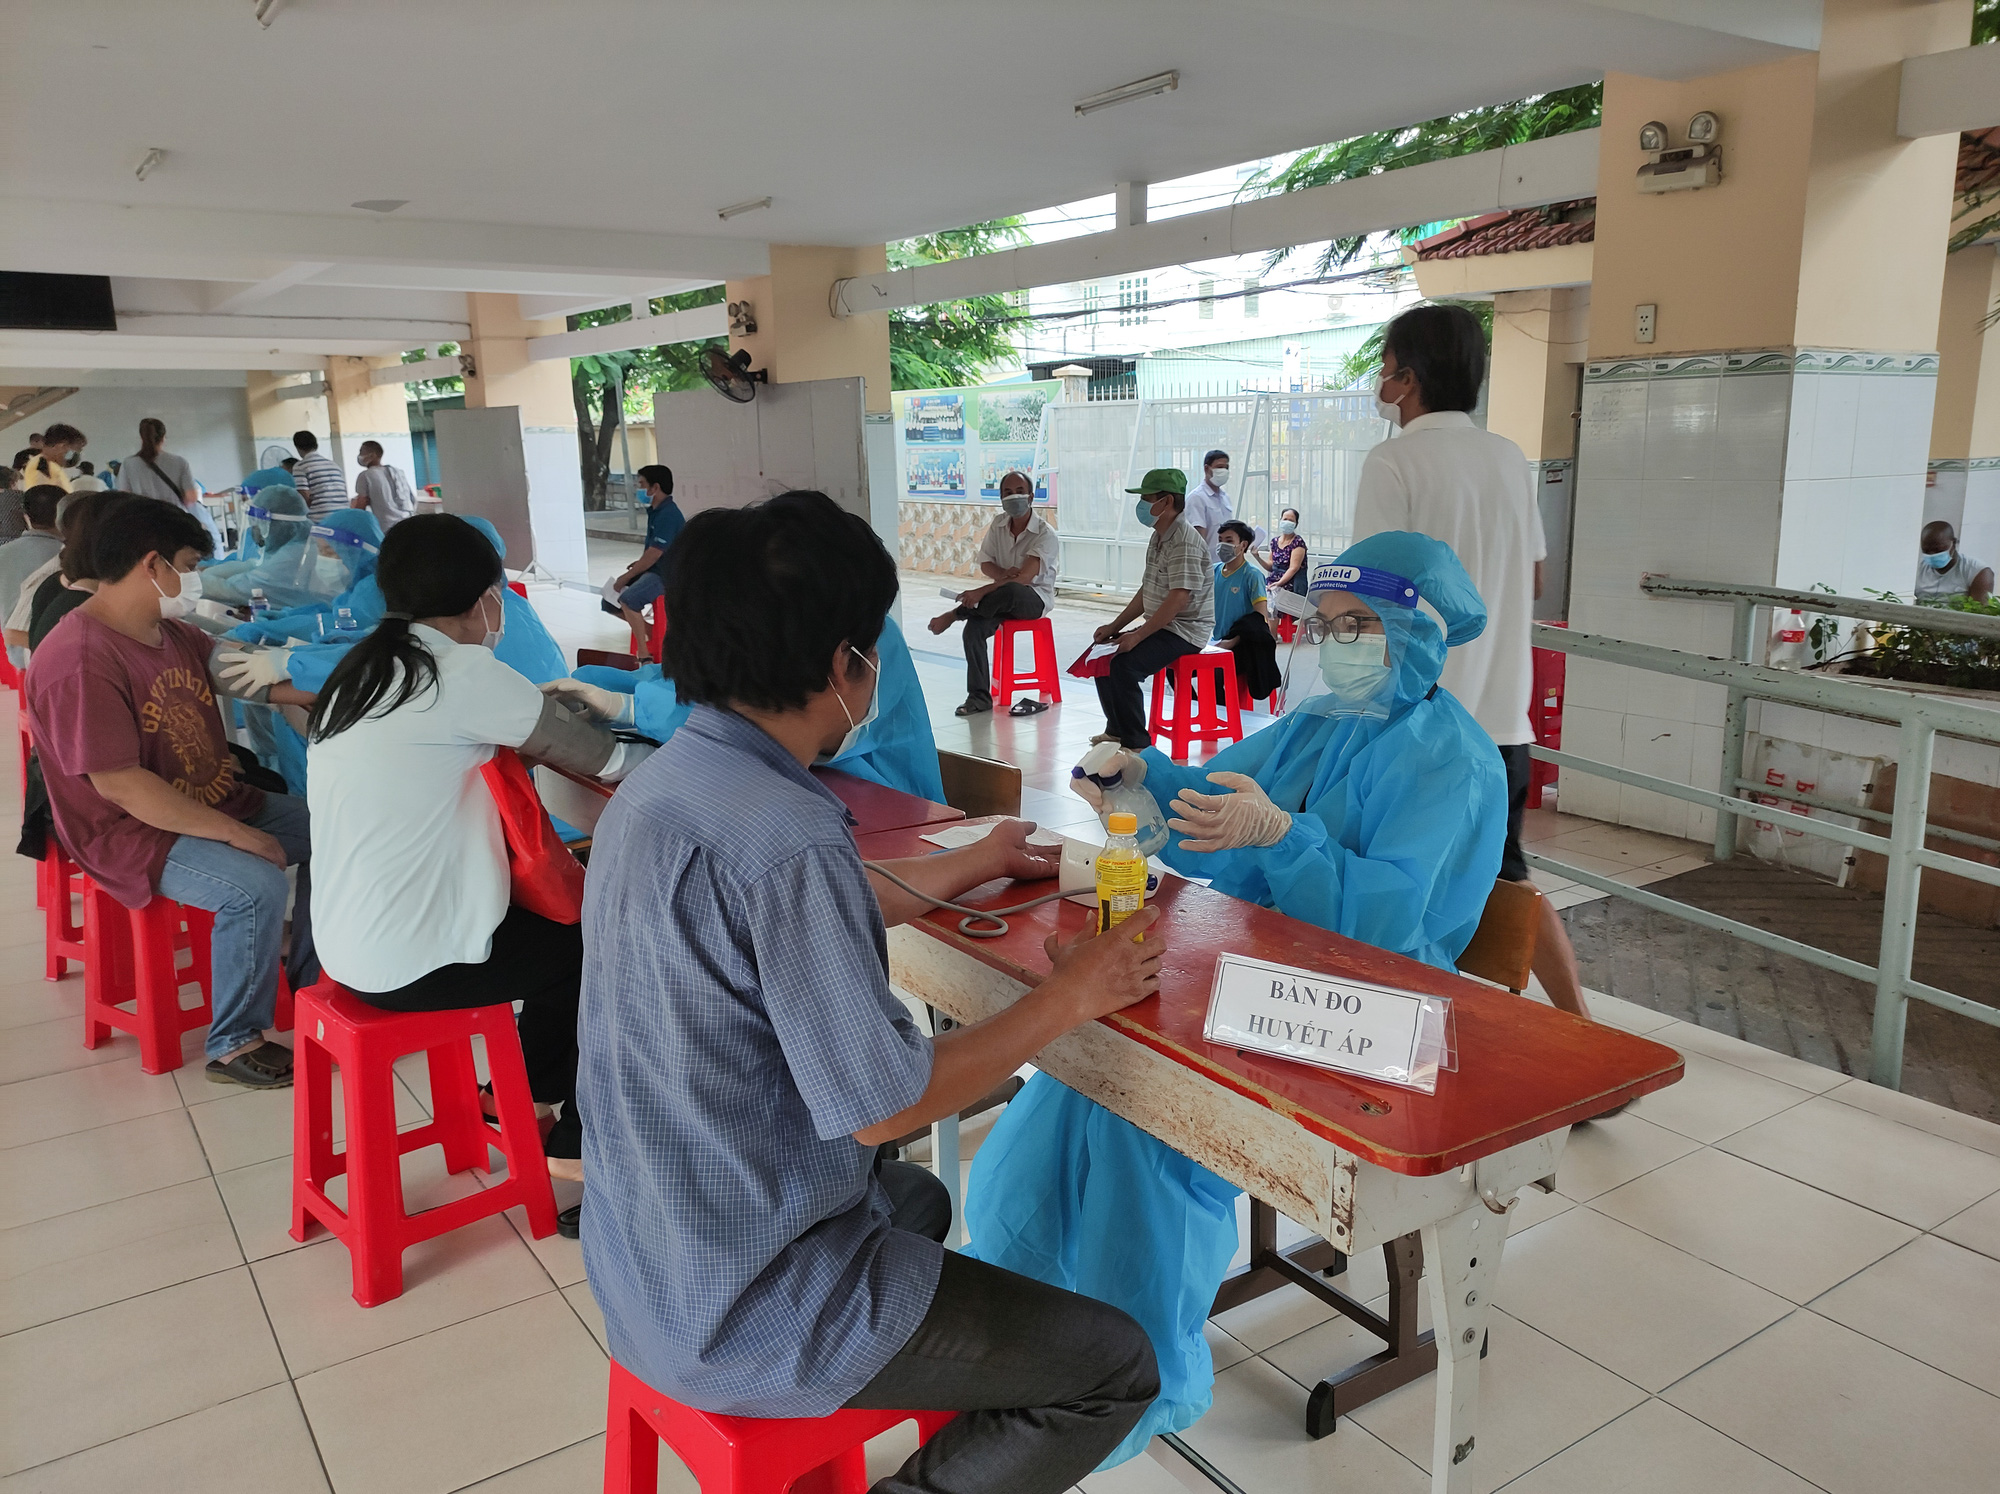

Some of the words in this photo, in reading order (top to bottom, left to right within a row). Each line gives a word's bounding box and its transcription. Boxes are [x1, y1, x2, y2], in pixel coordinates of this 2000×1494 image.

[1317, 568, 1352, 579] shield
[1269, 978, 1319, 1007] BÀN
[1325, 991, 1362, 1015] ĐO
[1247, 1014, 1333, 1049] HUYẾT
[1338, 1028, 1373, 1056] ÁP
